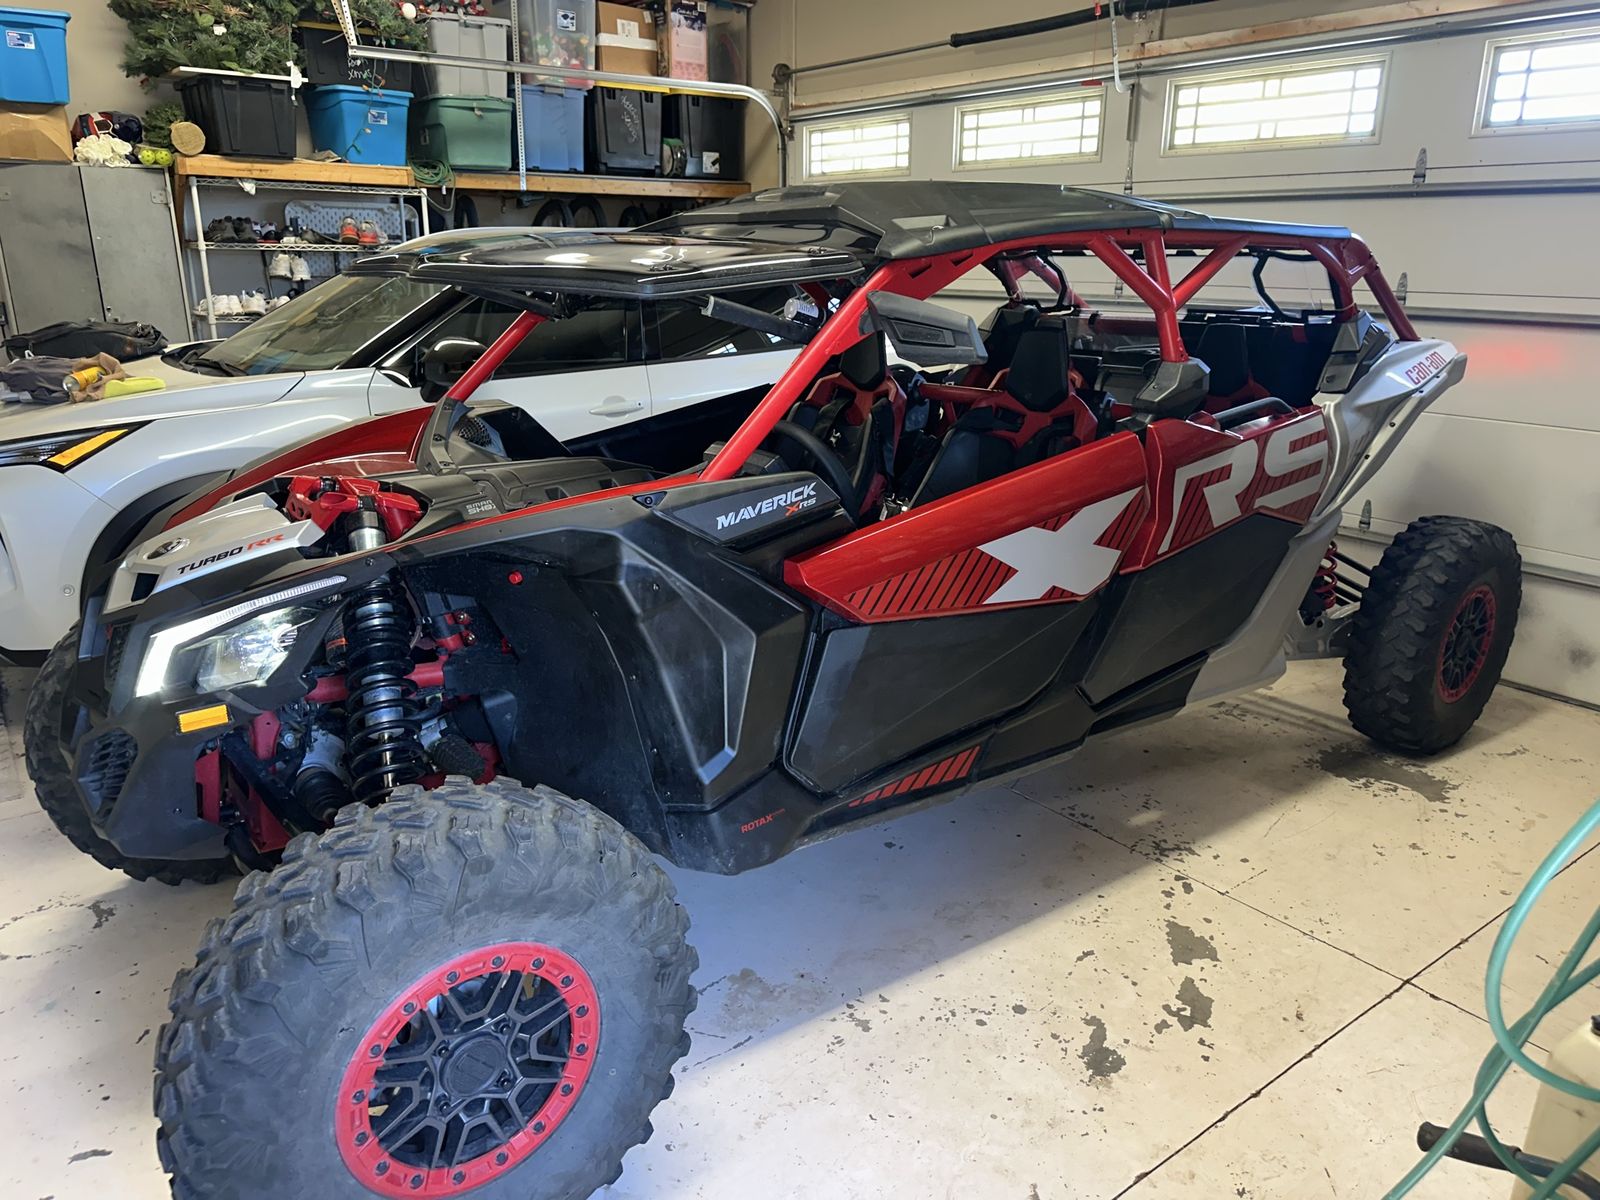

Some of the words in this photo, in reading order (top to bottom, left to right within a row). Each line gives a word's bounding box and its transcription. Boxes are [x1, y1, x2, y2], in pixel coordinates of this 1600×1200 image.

[1405, 351, 1447, 386] can-am
[716, 482, 817, 530] MAVERICK
[177, 546, 244, 575] TURBO
[246, 534, 284, 551] RR
[741, 814, 773, 833] ROTAX
